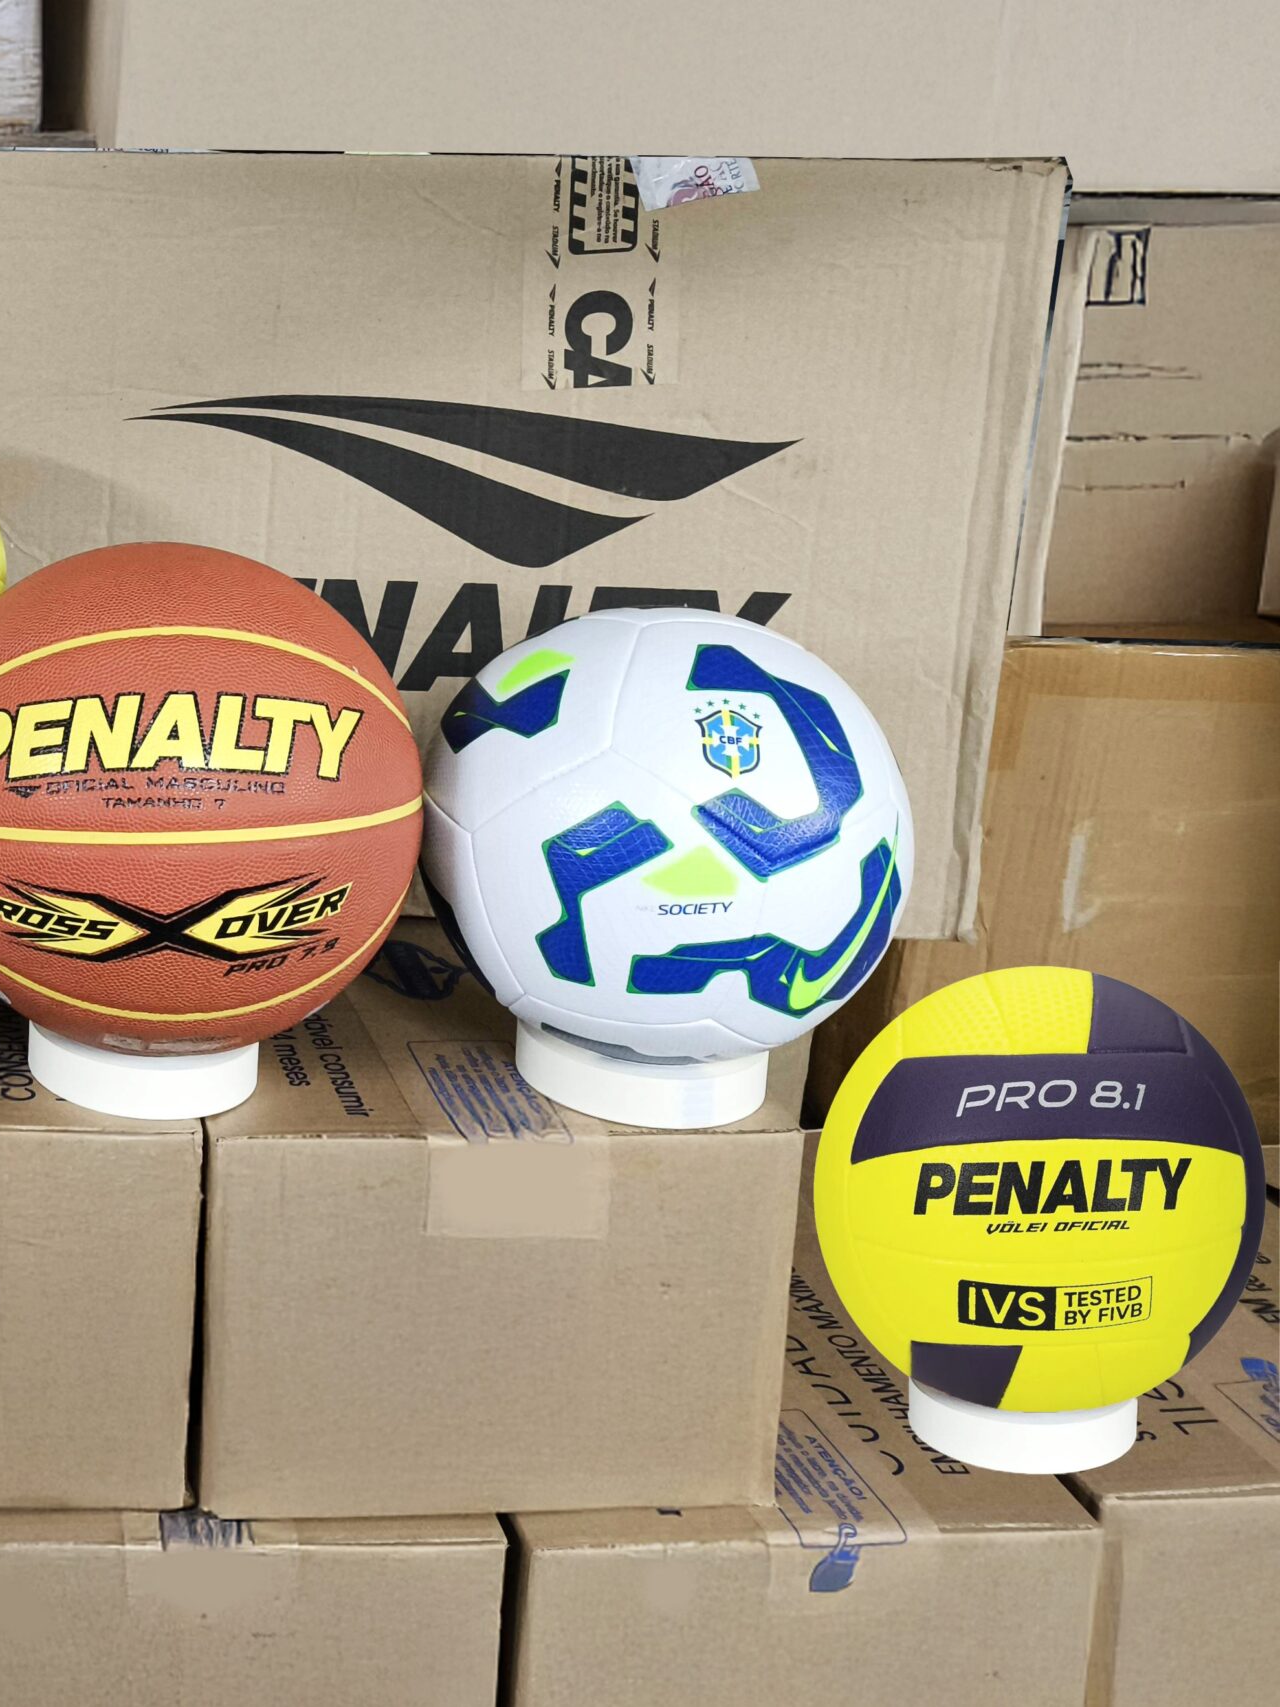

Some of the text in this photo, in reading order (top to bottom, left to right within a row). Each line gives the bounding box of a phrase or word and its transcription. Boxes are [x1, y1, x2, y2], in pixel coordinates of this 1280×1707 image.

[551, 179, 561, 256] PENALTY STADIUM
[651, 218, 660, 250] STADIUM
[547, 304, 556, 380] PENALTY STADIUM
[646, 299, 656, 374] PENALTY STADIUM
[719, 735, 743, 746] CBF
[45, 777, 285, 795] OFICIAL MASCULINO
[101, 797, 203, 810] TAMANHO
[213, 884, 350, 941] OVER
[657, 902, 734, 916] SOCIETY
[223, 955, 289, 977] PRO
[273, 1043, 311, 1088] meses
[319, 1053, 374, 1118] consumir
[956, 1079, 1147, 1118] PRO 8.1
[913, 1157, 1193, 1216] PENALTY
[986, 1219, 1130, 1235] VÔLEI OFICIAL
[968, 1287, 1047, 1327] IVS
[1063, 1285, 1141, 1308] TESTED
[1064, 1303, 1143, 1327] BY FIVB
